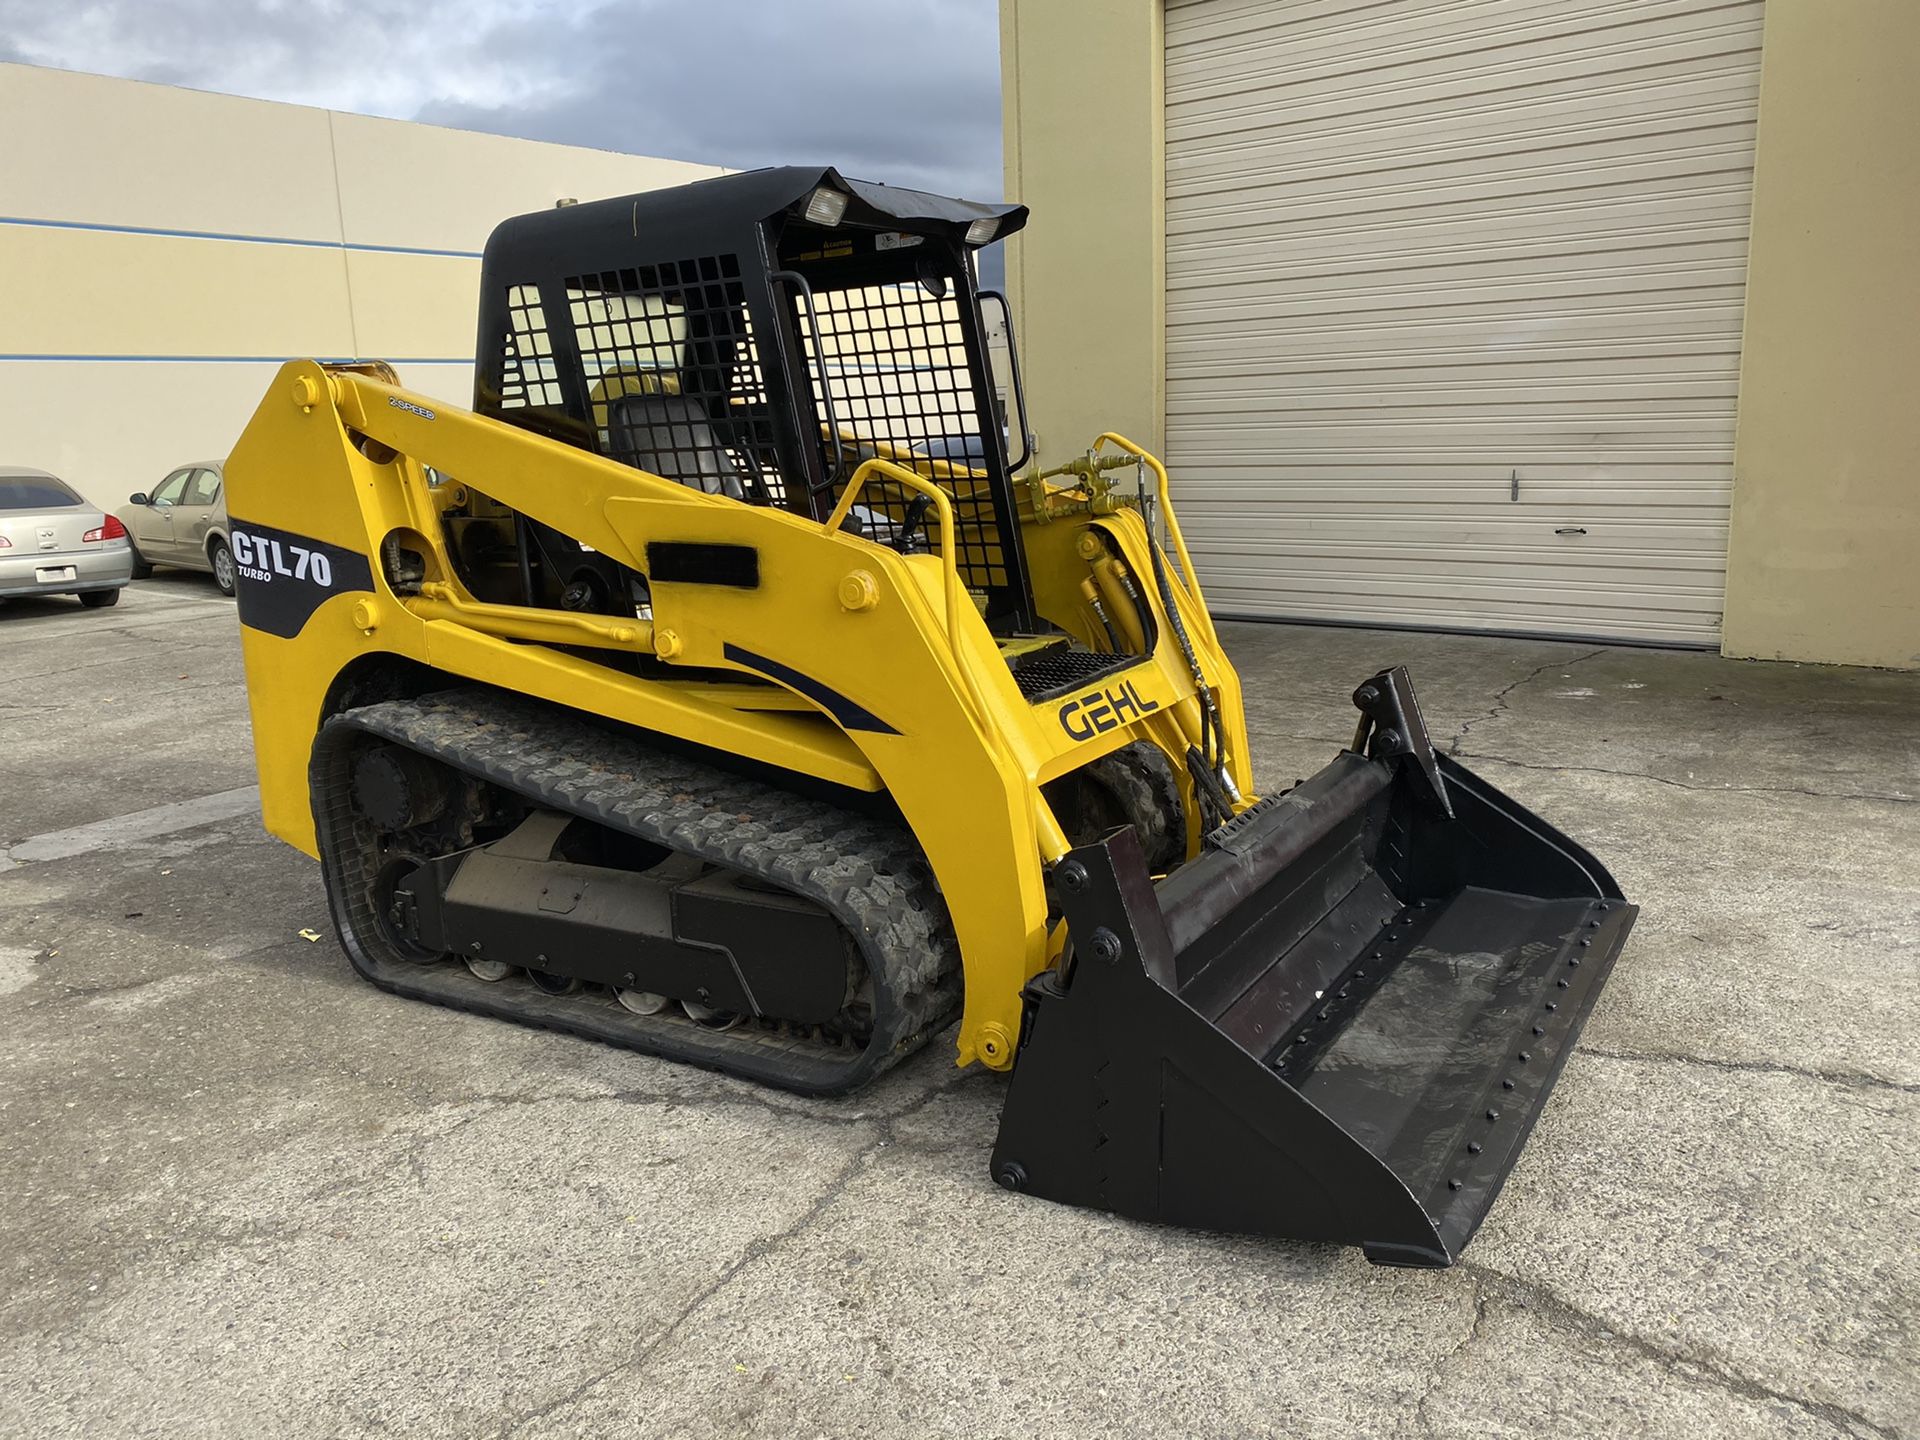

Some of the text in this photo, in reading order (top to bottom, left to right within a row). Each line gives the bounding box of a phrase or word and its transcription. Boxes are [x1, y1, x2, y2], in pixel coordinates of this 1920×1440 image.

[389, 396, 435, 420] 2-SPEED
[231, 530, 332, 587] CTL70
[237, 565, 272, 583] TURBO
[1059, 679, 1159, 742] GEHL
